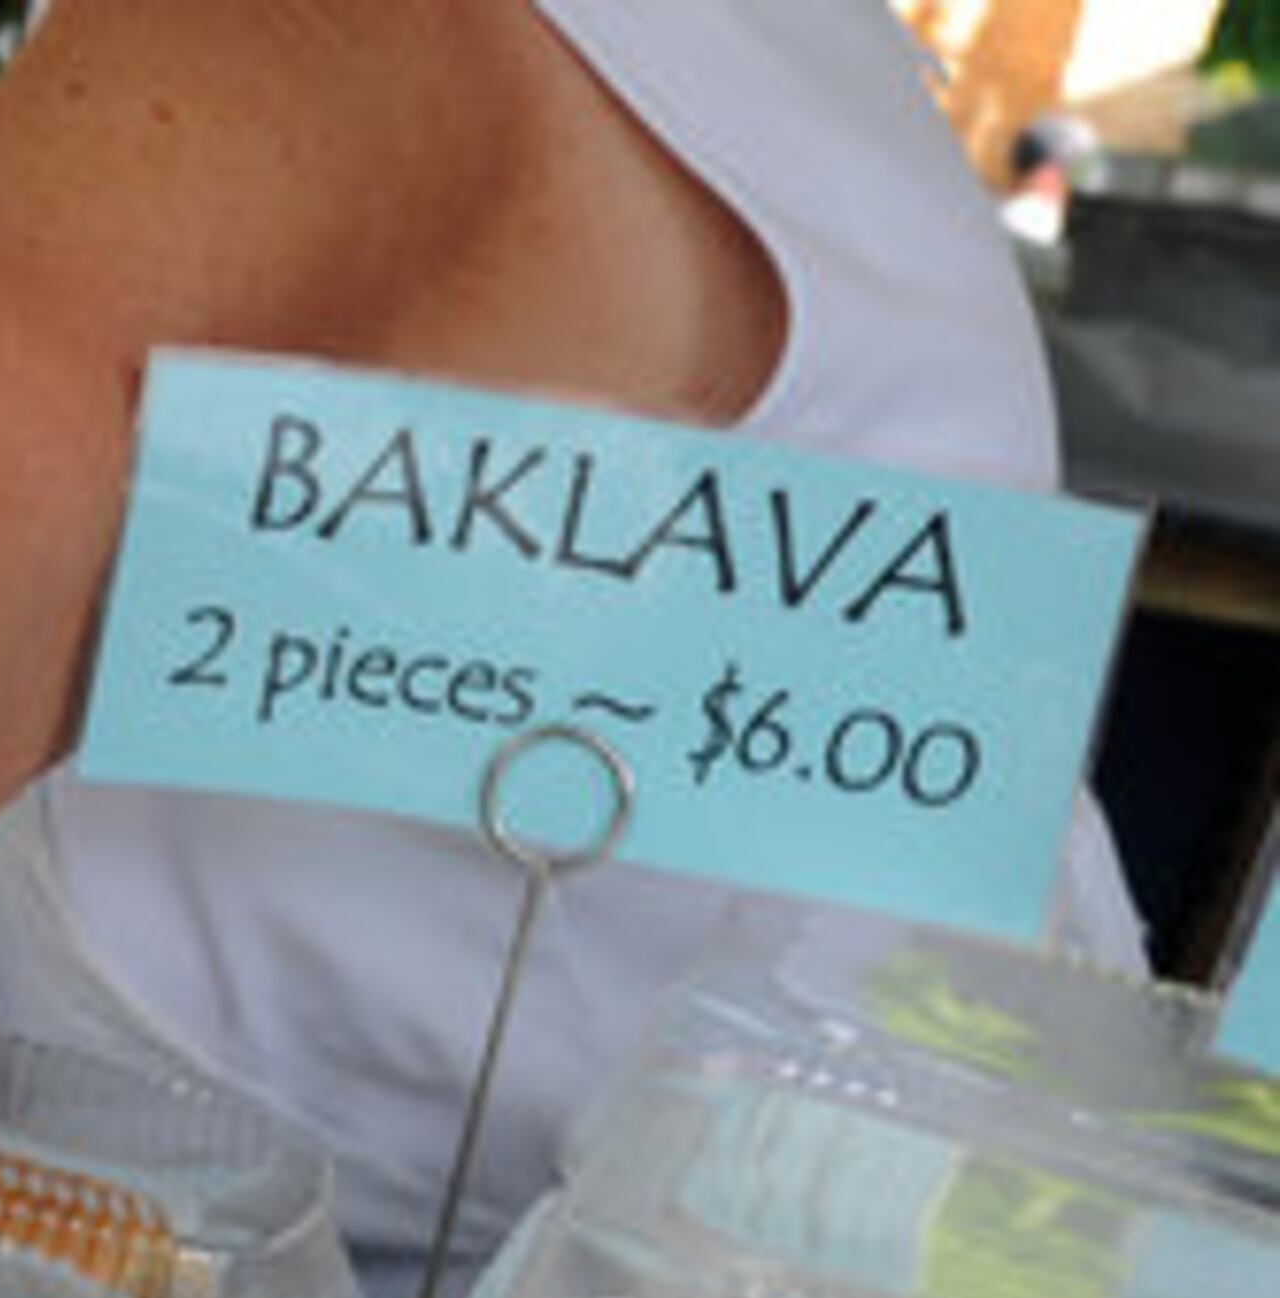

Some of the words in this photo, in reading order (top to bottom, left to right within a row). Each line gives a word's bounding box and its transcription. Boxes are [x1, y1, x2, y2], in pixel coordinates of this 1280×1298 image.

[249, 412, 968, 638] BAKLAVA
[167, 605, 236, 688] 2
[256, 624, 536, 724] pieces
[685, 661, 981, 807] $6.00
